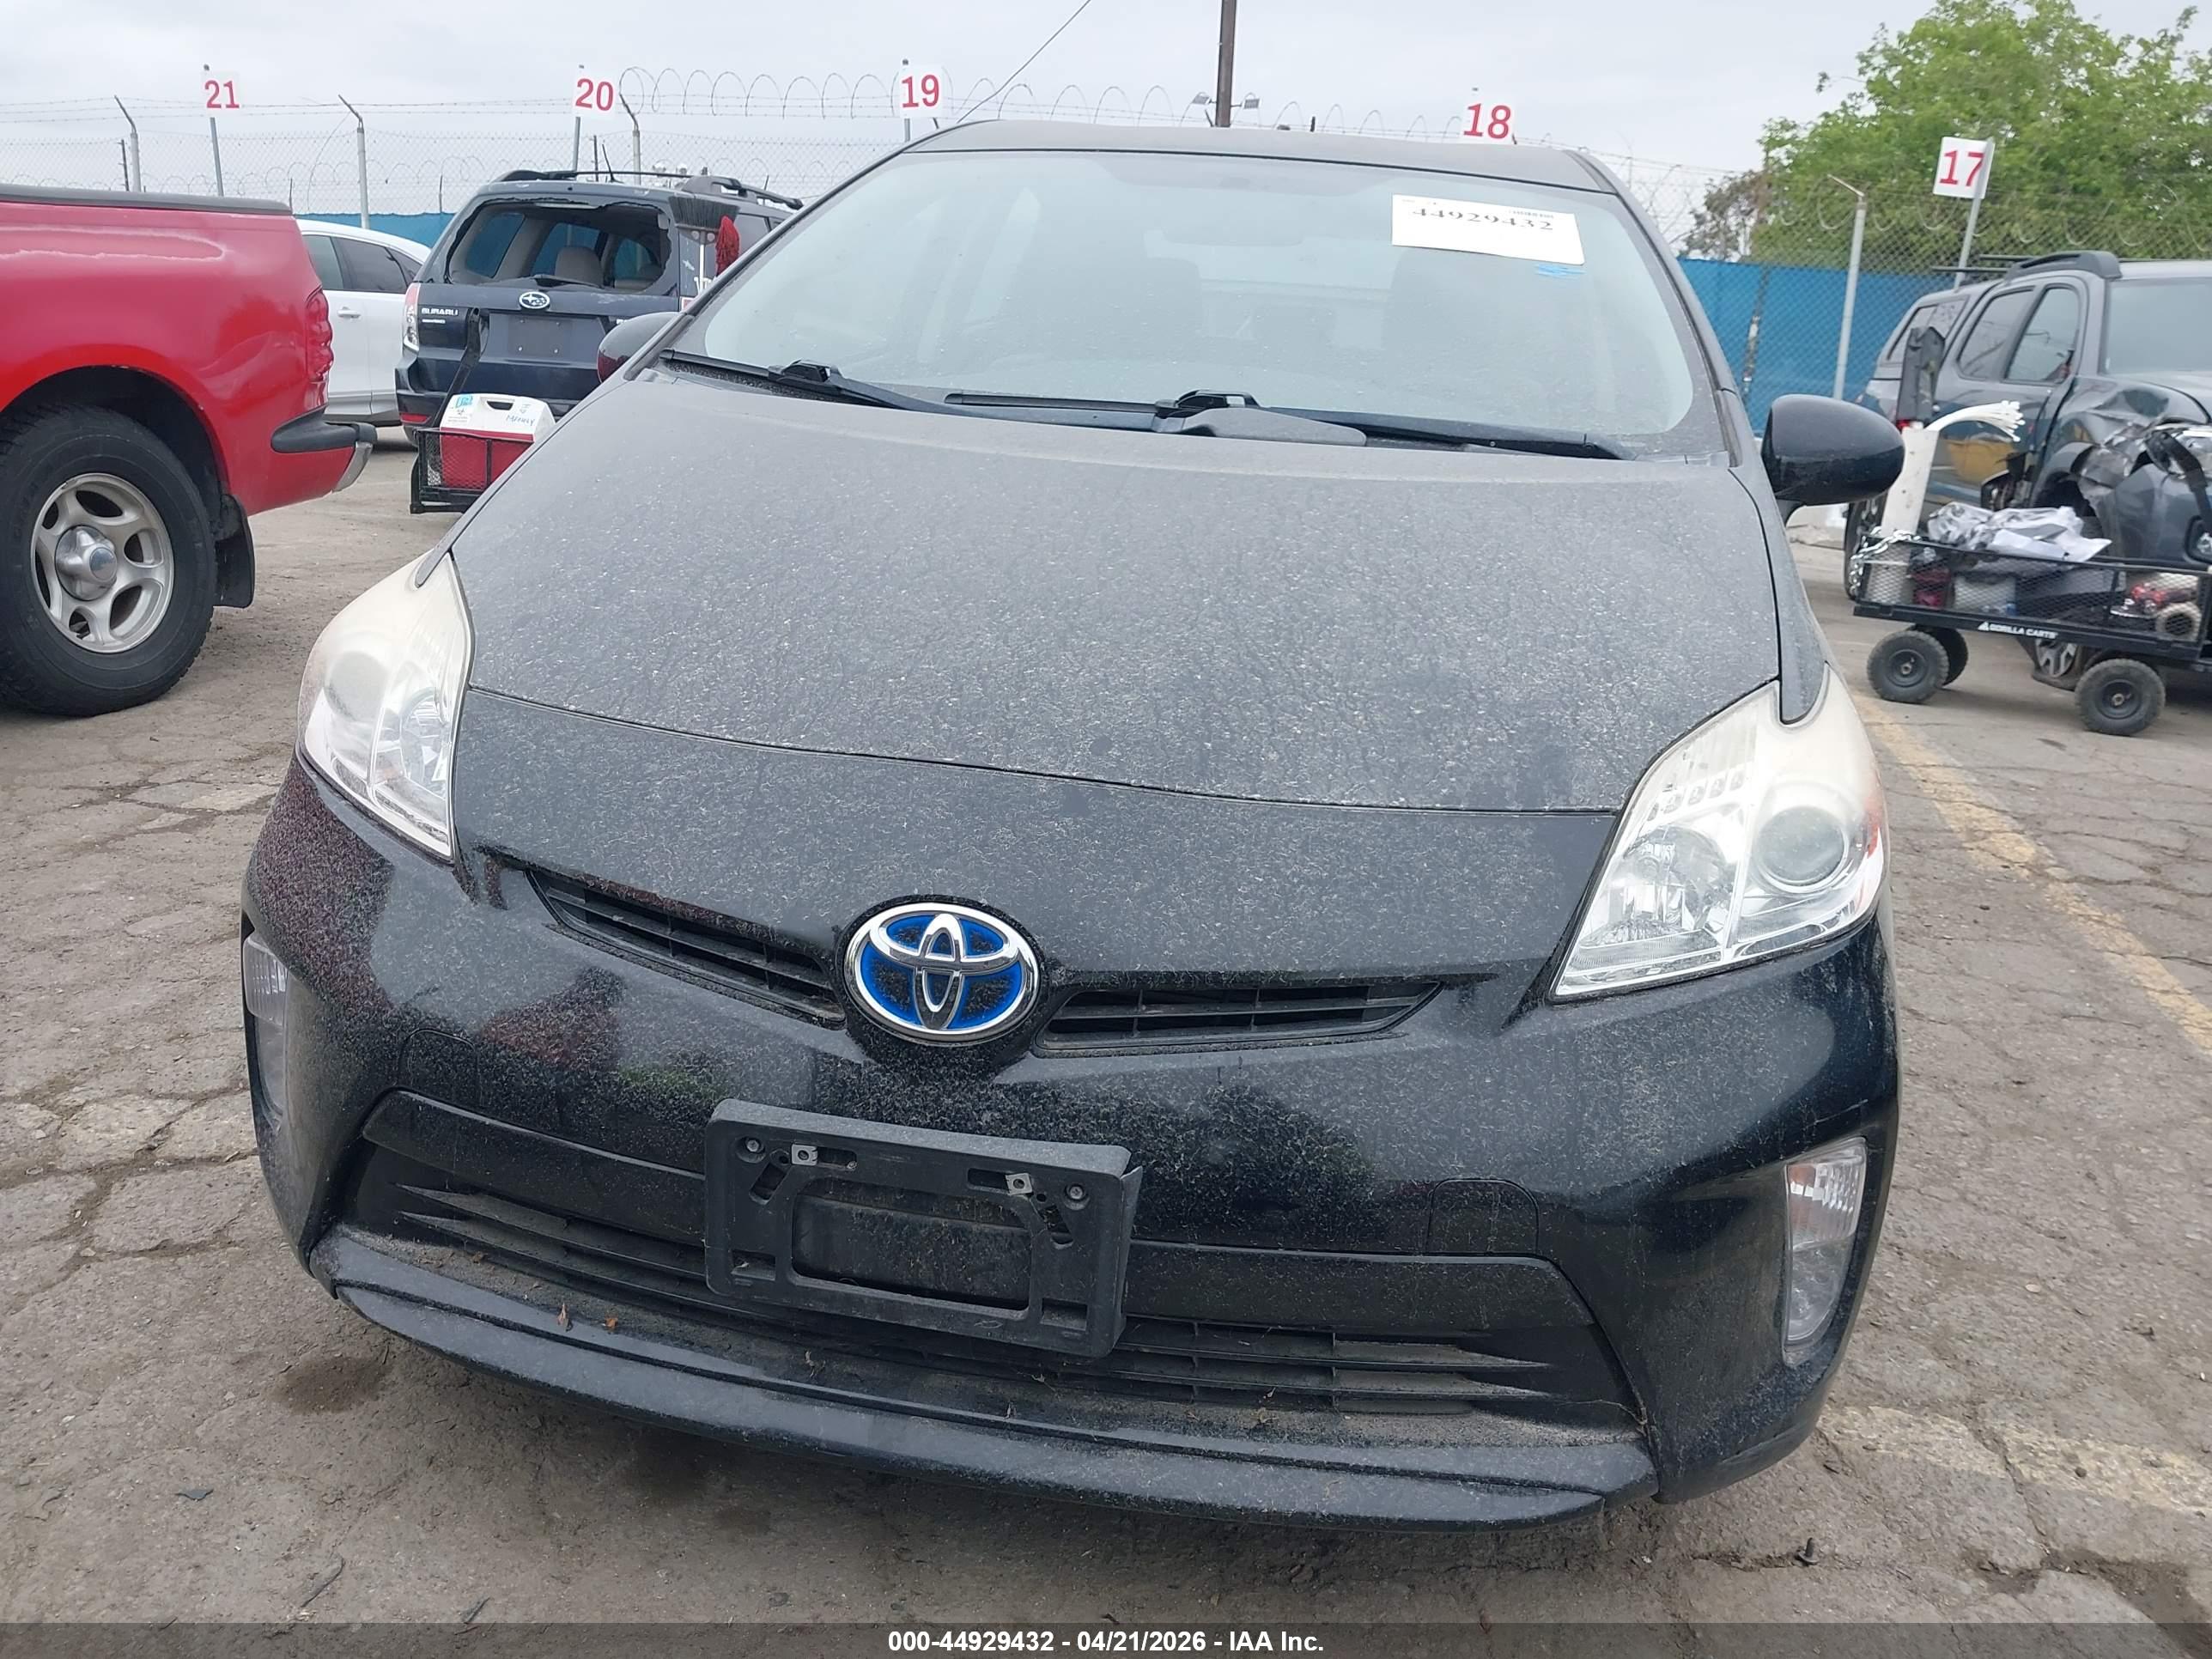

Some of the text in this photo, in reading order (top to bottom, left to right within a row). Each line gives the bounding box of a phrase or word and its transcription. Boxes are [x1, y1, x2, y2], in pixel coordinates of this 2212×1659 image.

[204, 80, 240, 108] 21
[575, 78, 614, 112] 20
[902, 74, 939, 107] 19
[1463, 103, 1511, 139] 18
[1939, 149, 1985, 187] 17
[1413, 207, 1553, 231] 44929432
[421, 307, 459, 316] SUBARU
